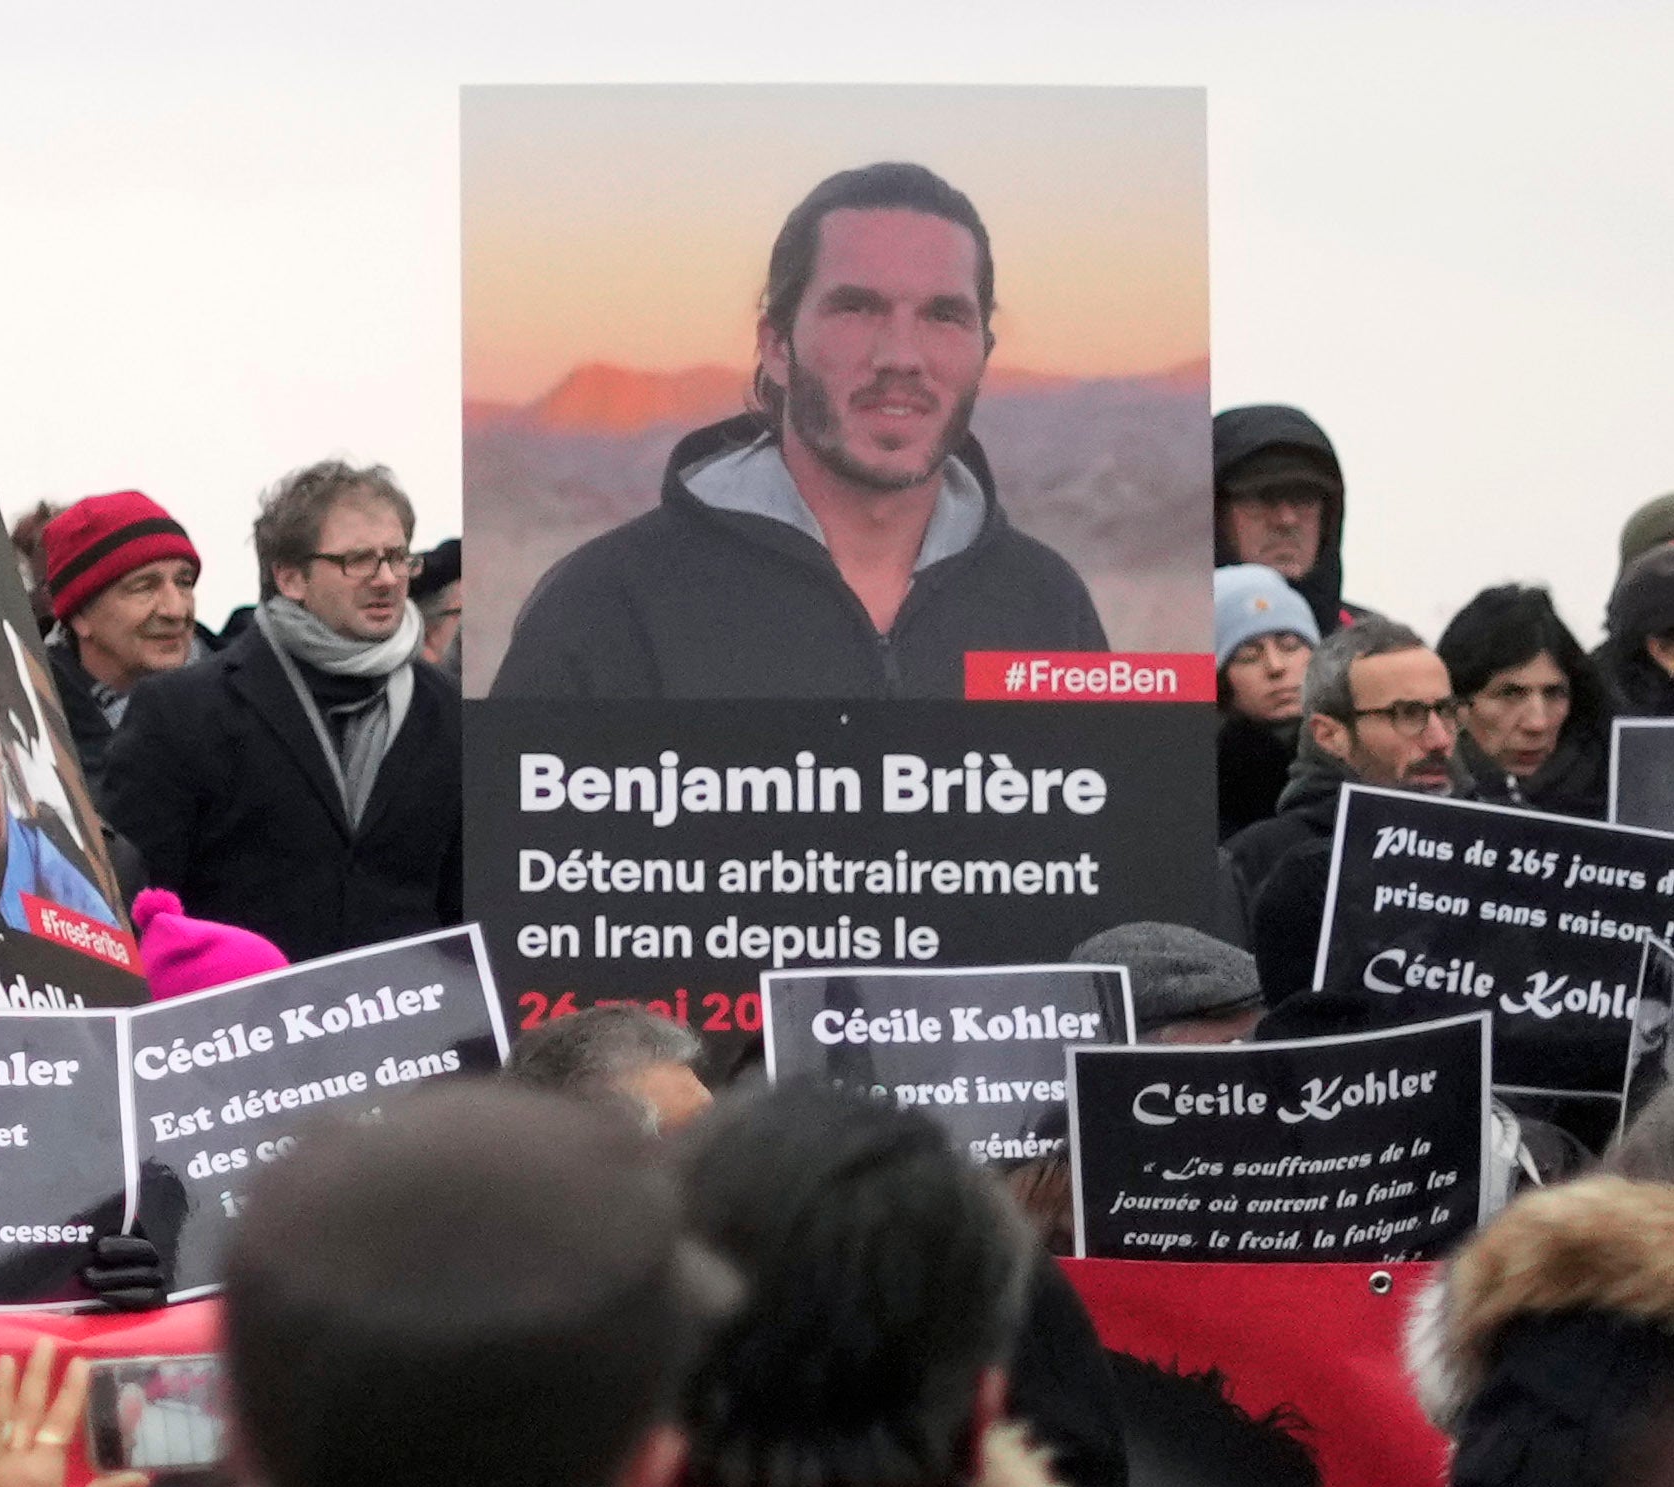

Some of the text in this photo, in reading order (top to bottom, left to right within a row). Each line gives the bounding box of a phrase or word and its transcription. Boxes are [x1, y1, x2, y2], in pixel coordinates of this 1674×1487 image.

[1006, 661, 1177, 694] #FreeBen
[519, 751, 1107, 826] Benjamin Brière
[518, 849, 1099, 895] Détenu arbitrairement
[1372, 826, 1454, 861] Plus
[1464, 840, 1497, 868] de
[1507, 848, 1559, 880] 265
[1564, 854, 1646, 890] jours
[1374, 882, 1470, 916] prison
[1480, 901, 1547, 928] sans
[41, 908, 130, 964] #FreeFariba
[518, 917, 939, 967] en Iran depuis le
[1363, 948, 1637, 1020] Cécile Kohl
[133, 983, 444, 1080] Cécile Kohler
[701, 992, 763, 1031] 20
[812, 1005, 1100, 1044] Cécile Kohler
[150, 1106, 214, 1141] Est
[220, 1071, 367, 1124] détenue
[375, 1049, 460, 1086] dans
[894, 1077, 969, 1111] prof
[975, 1076, 1067, 1103] inves
[1132, 1068, 1437, 1125] Cécile Kohler
[187, 1147, 250, 1180] des
[969, 1132, 1064, 1163] génér
[1162, 1157, 1223, 1180] Les
[1233, 1152, 1372, 1177] souffrances
[1380, 1143, 1405, 1164] de
[1411, 1137, 1432, 1158] la
[1109, 1190, 1201, 1214] journée
[1209, 1194, 1238, 1213] où
[1247, 1194, 1329, 1213] entrent
[1336, 1189, 1358, 1209] la
[1426, 1169, 1458, 1190] les
[0, 1223, 94, 1244] cesser
[1209, 1229, 1229, 1248] le
[1313, 1229, 1335, 1249] la
[1430, 1207, 1450, 1225] la
